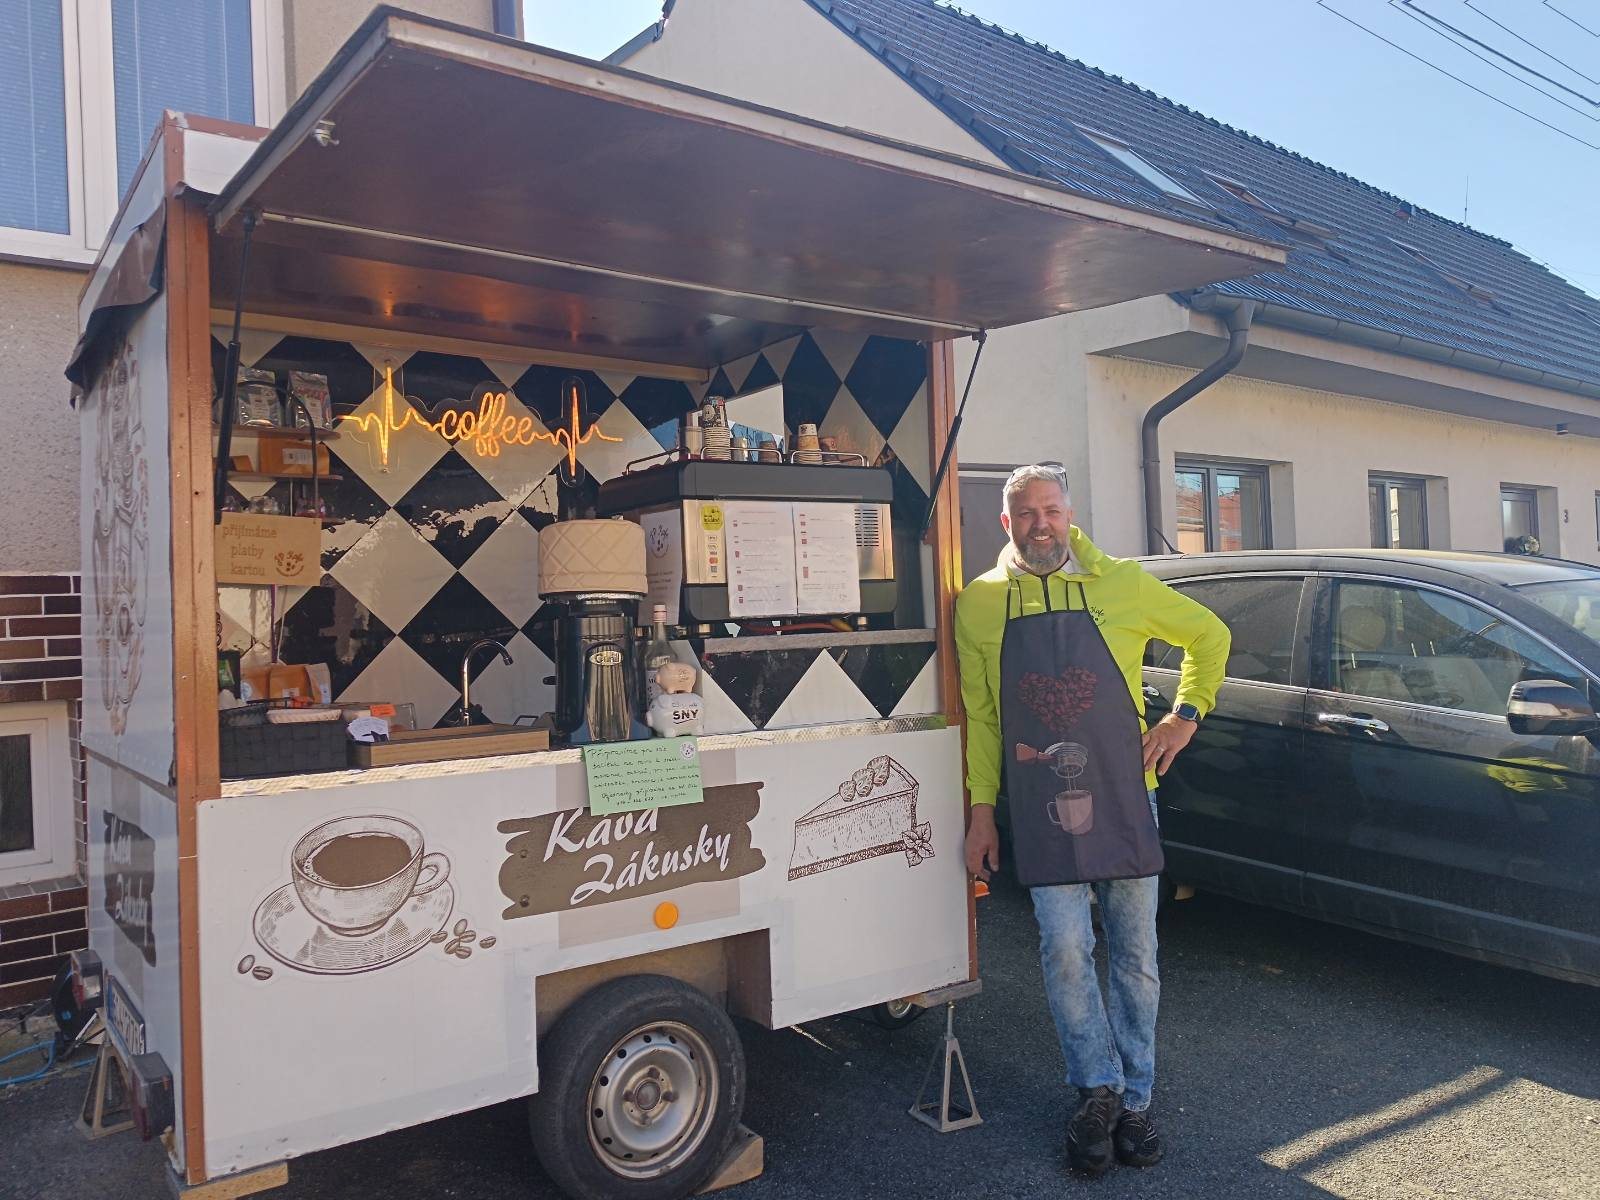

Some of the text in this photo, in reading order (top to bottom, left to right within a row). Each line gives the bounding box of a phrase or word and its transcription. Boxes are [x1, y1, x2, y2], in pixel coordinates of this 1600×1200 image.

[441, 392, 536, 457] coffee
[231, 543, 265, 560] platby
[231, 562, 265, 577] kartou
[672, 709, 699, 720] SNY
[543, 806, 659, 863] Káva
[570, 823, 732, 906] Zákusky
